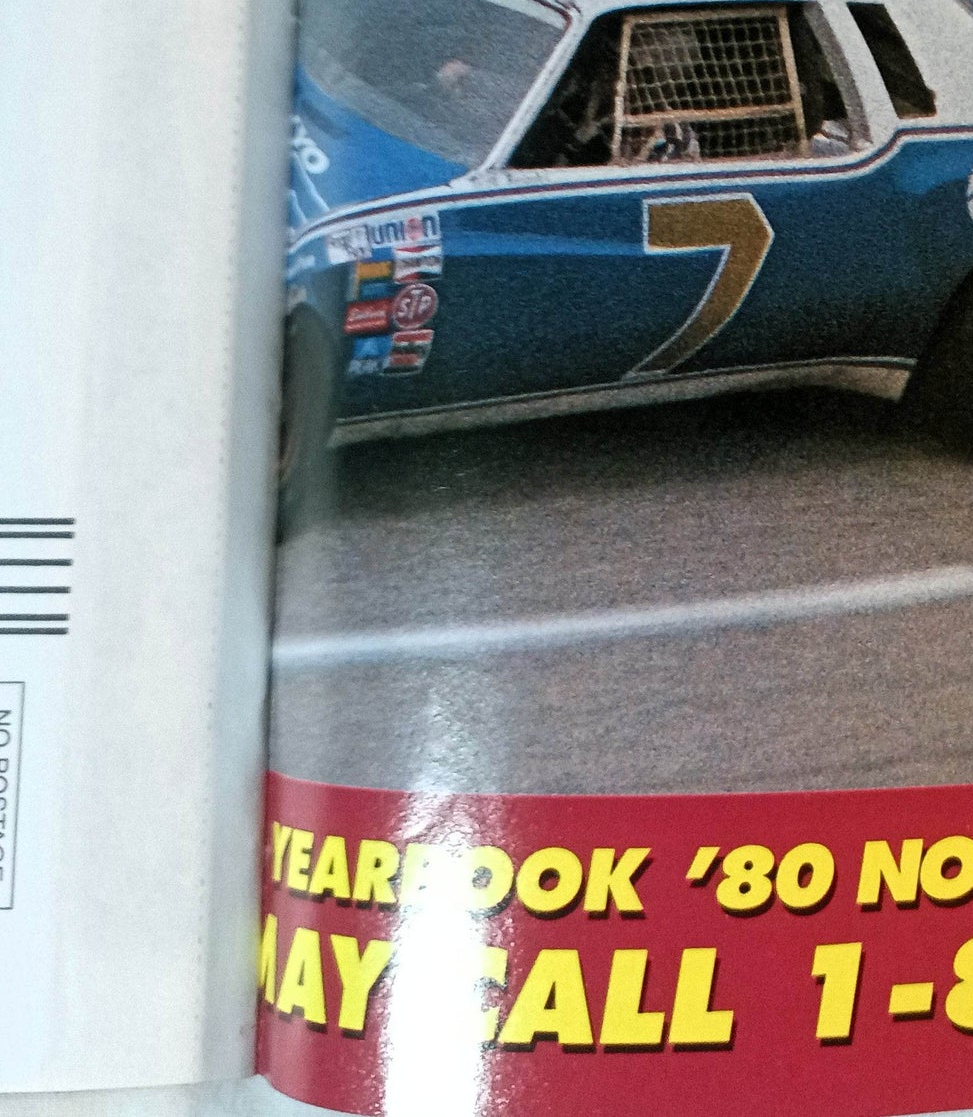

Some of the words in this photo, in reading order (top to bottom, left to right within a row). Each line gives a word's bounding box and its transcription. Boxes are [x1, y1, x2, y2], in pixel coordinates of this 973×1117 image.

[397, 289, 433, 320] STP
[624, 192, 775, 380] 7
[272, 821, 652, 916] YEARBOOK
